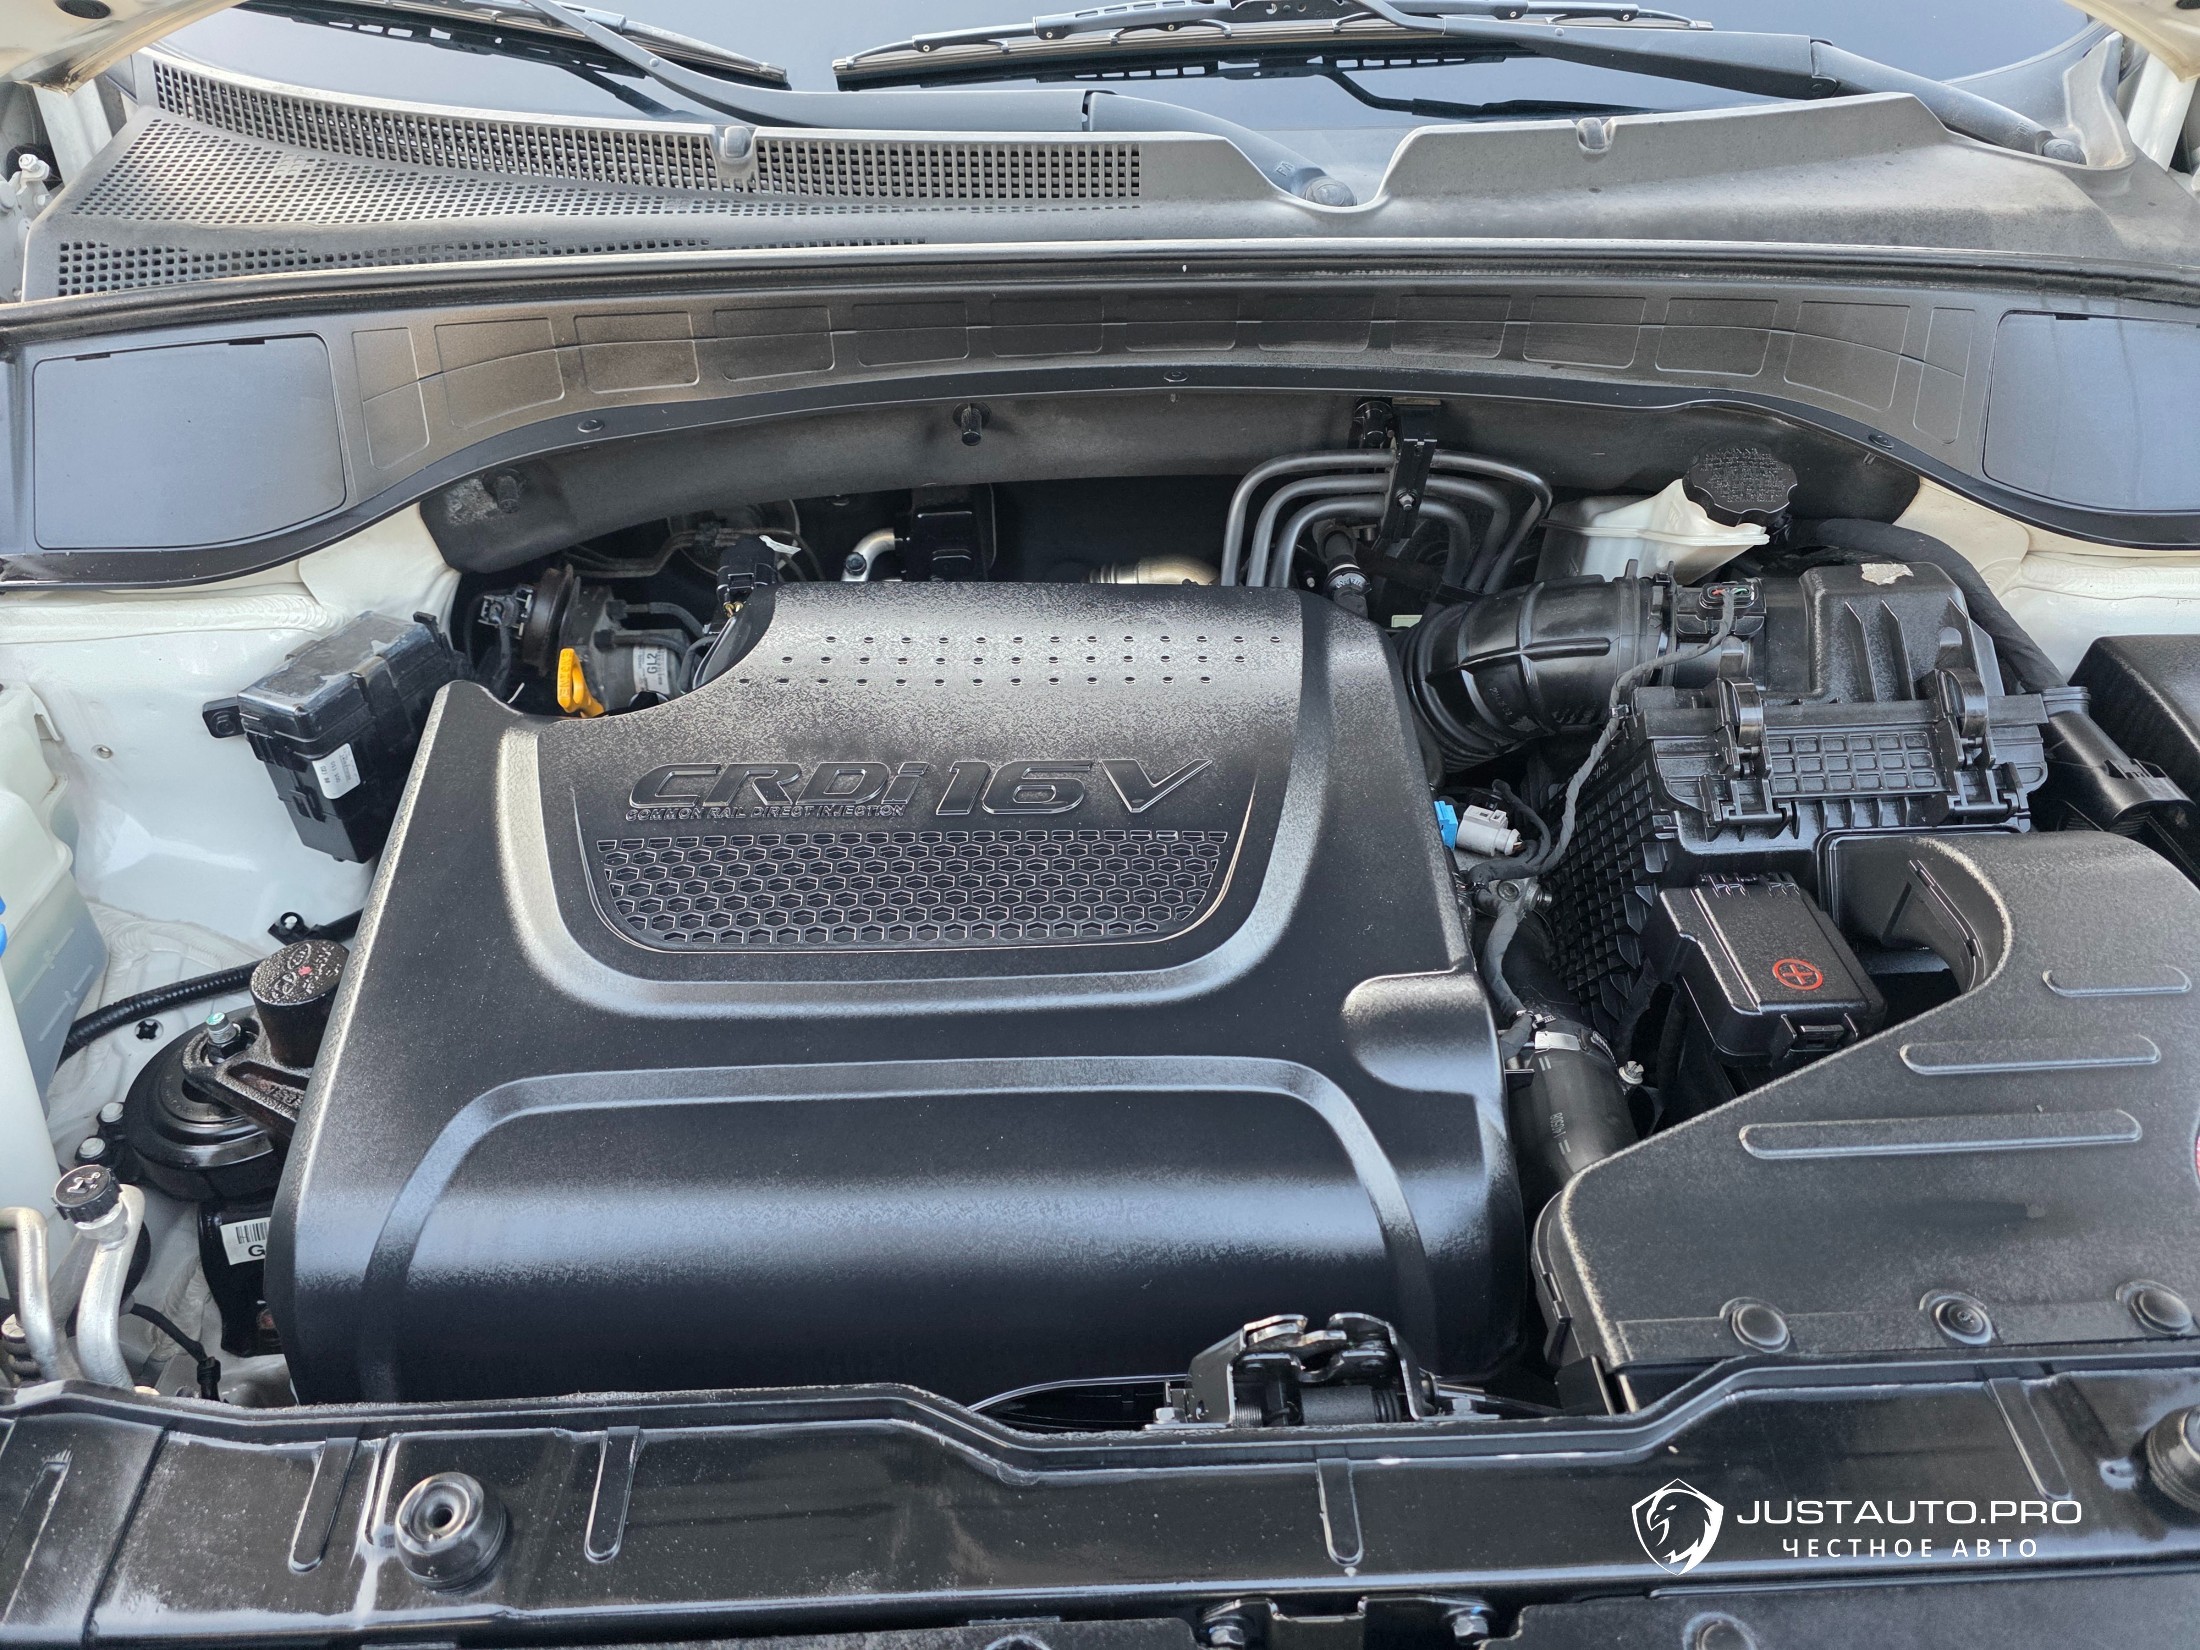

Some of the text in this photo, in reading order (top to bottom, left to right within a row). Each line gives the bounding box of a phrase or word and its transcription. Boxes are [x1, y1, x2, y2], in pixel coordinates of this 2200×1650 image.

[646, 652, 658, 675] GL2
[629, 761, 931, 808] CRDi
[625, 804, 907, 822] COMMON RAIL DIRECT INJECTION
